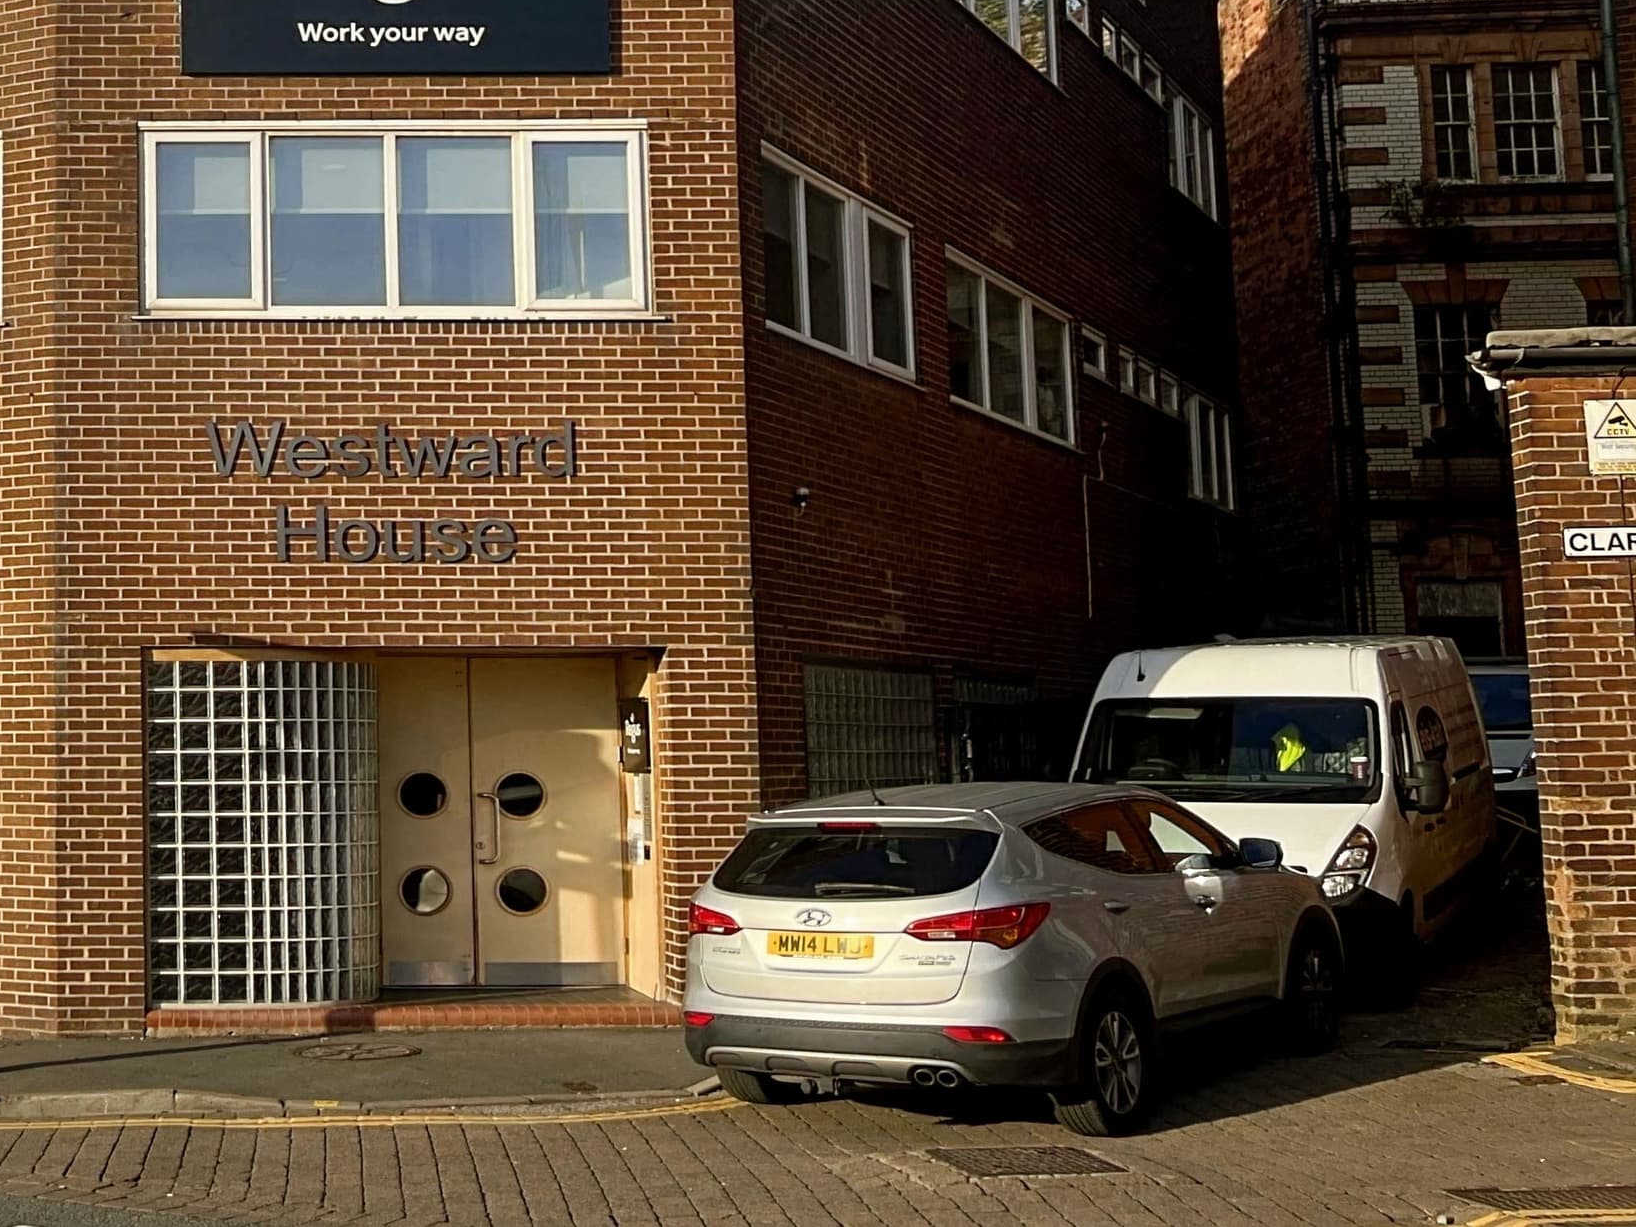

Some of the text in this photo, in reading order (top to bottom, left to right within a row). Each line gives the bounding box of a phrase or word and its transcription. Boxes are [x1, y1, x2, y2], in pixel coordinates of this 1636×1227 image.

[296, 22, 486, 47] Work your way
[1606, 428, 1630, 436] CCTV
[206, 420, 578, 478] Westward
[275, 503, 518, 564] House
[777, 933, 818, 953] MW14
